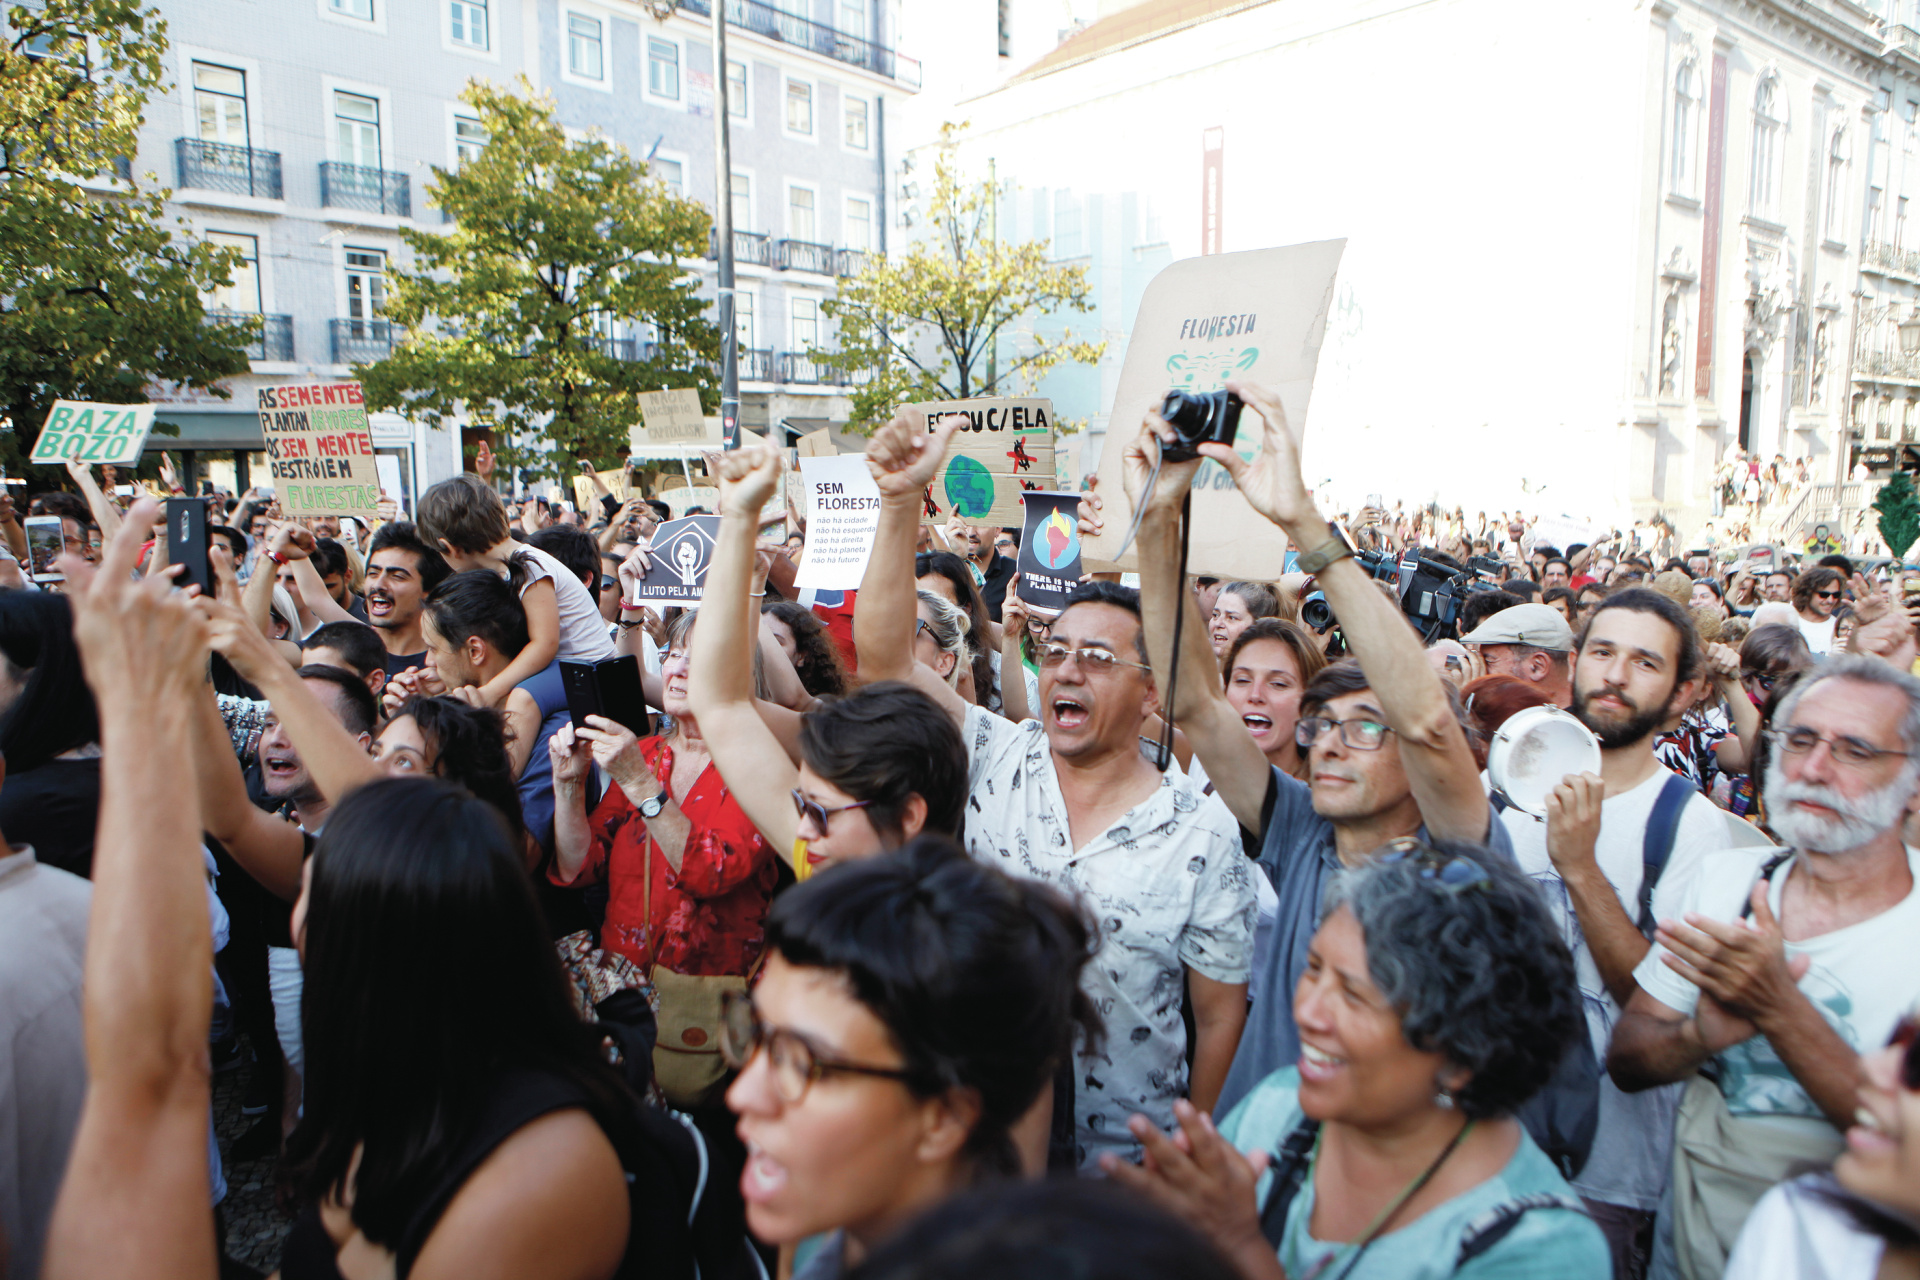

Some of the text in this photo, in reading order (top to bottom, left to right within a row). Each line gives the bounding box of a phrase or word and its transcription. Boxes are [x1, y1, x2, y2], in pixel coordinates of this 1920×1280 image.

[258, 387, 277, 409] AS
[277, 384, 364, 408] SEMENTES
[48, 407, 143, 438] BAZA,
[311, 407, 368, 431] ÁRVORES
[35, 432, 128, 460] BOZO
[266, 432, 372, 459] OS SEM MENTE
[816, 483, 844, 494] SEM
[287, 485, 377, 509] FLORESTAS
[817, 498, 880, 510] FLORESTA
[833, 516, 842, 524] há
[832, 526, 841, 534] há
[843, 526, 876, 535] esquerda
[830, 536, 840, 544] há
[839, 547, 866, 555] planeta
[1025, 572, 1077, 589] THERE IS NO
[643, 586, 666, 596] LUTO
[668, 586, 688, 597] PELA
[1030, 581, 1062, 593] PLANET
